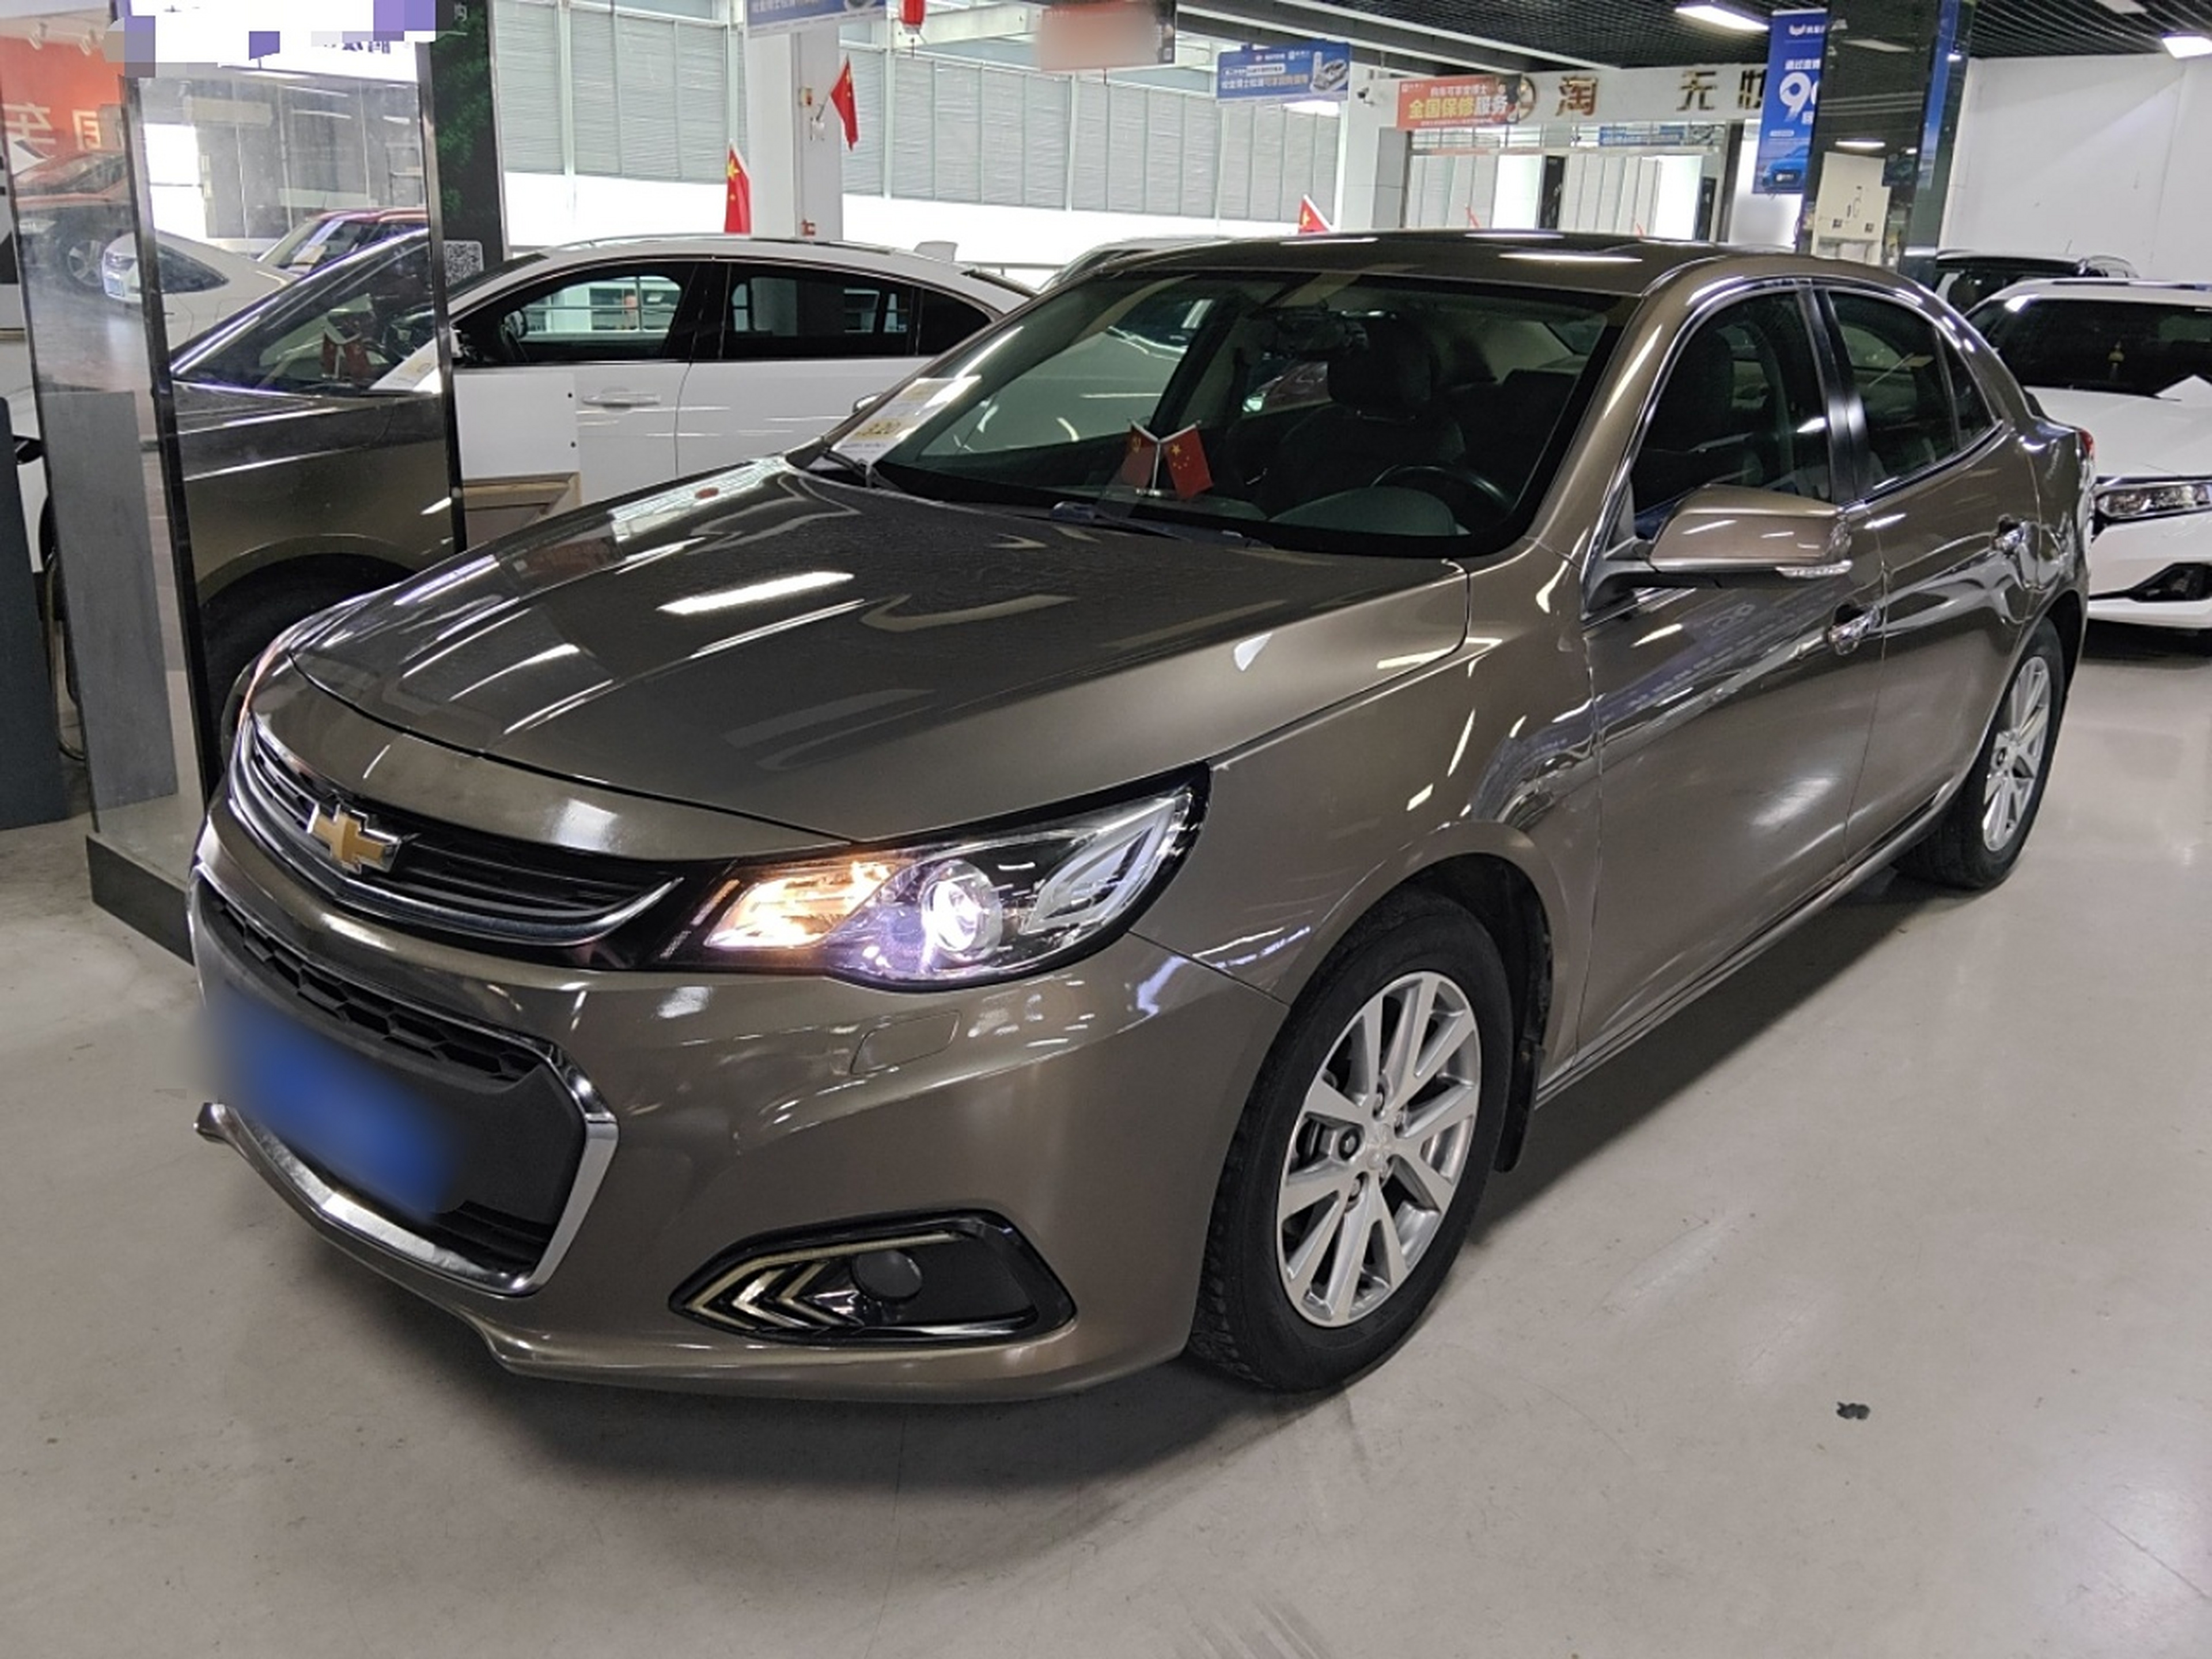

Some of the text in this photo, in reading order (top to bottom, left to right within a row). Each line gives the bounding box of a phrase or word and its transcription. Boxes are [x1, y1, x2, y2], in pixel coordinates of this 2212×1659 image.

[1408, 96, 1508, 119] 全国保修服务
[1555, 75, 1597, 116] 淘
